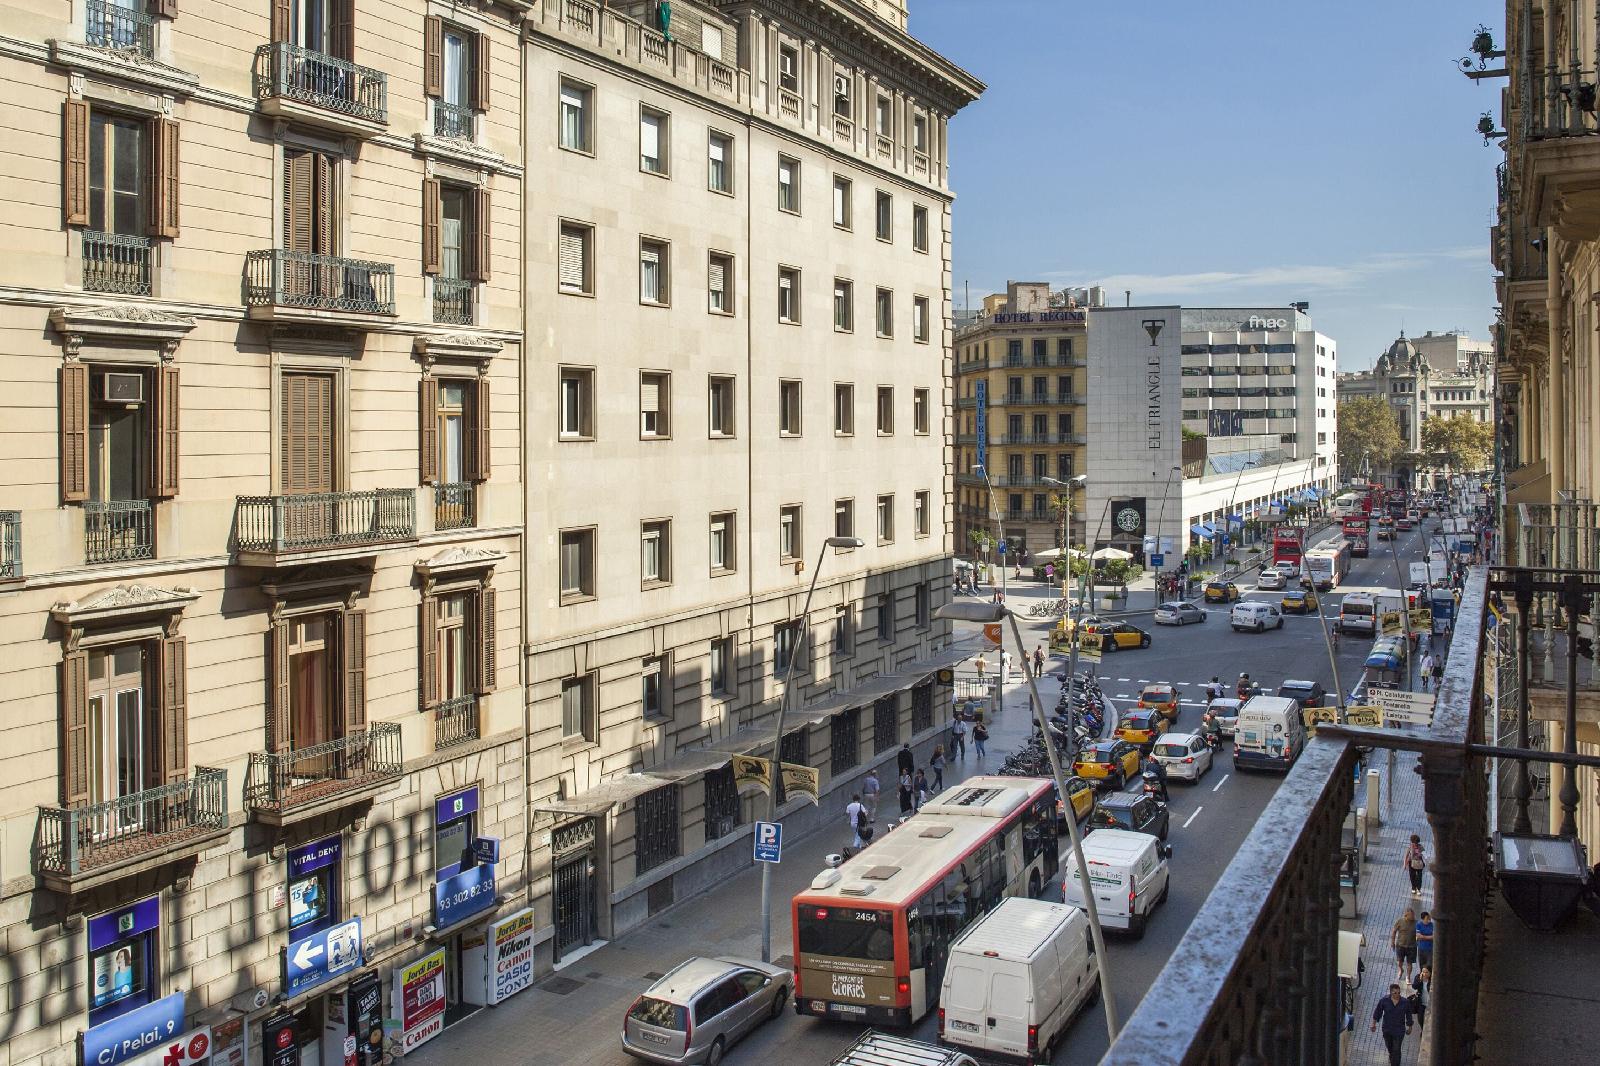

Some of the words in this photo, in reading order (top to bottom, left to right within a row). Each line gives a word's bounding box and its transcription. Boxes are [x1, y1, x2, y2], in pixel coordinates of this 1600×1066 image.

[994, 313, 1033, 323] HOTEL
[1040, 311, 1085, 321] REGINA
[1248, 314, 1287, 328] fnac
[977, 383, 985, 420] HOTEL
[760, 823, 776, 844] P
[293, 853, 316, 866] VITAL
[318, 844, 339, 857] DENT
[440, 897, 451, 910] 93
[453, 889, 469, 905] 302
[470, 884, 480, 896] 82
[483, 879, 493, 892] 33
[497, 919, 517, 938] Jordi
[497, 936, 531, 961] Nikon
[407, 963, 426, 982] Jordi
[427, 958, 440, 971] Bas
[497, 949, 531, 973] Canon
[496, 961, 531, 987] CASIO
[360, 989, 378, 1007] TAKE
[496, 973, 531, 1000] SONY
[98, 1043, 118, 1065] C/
[123, 1026, 163, 1055] Pelai,
[166, 1020, 175, 1034] 9
[405, 1020, 440, 1047] Canon
